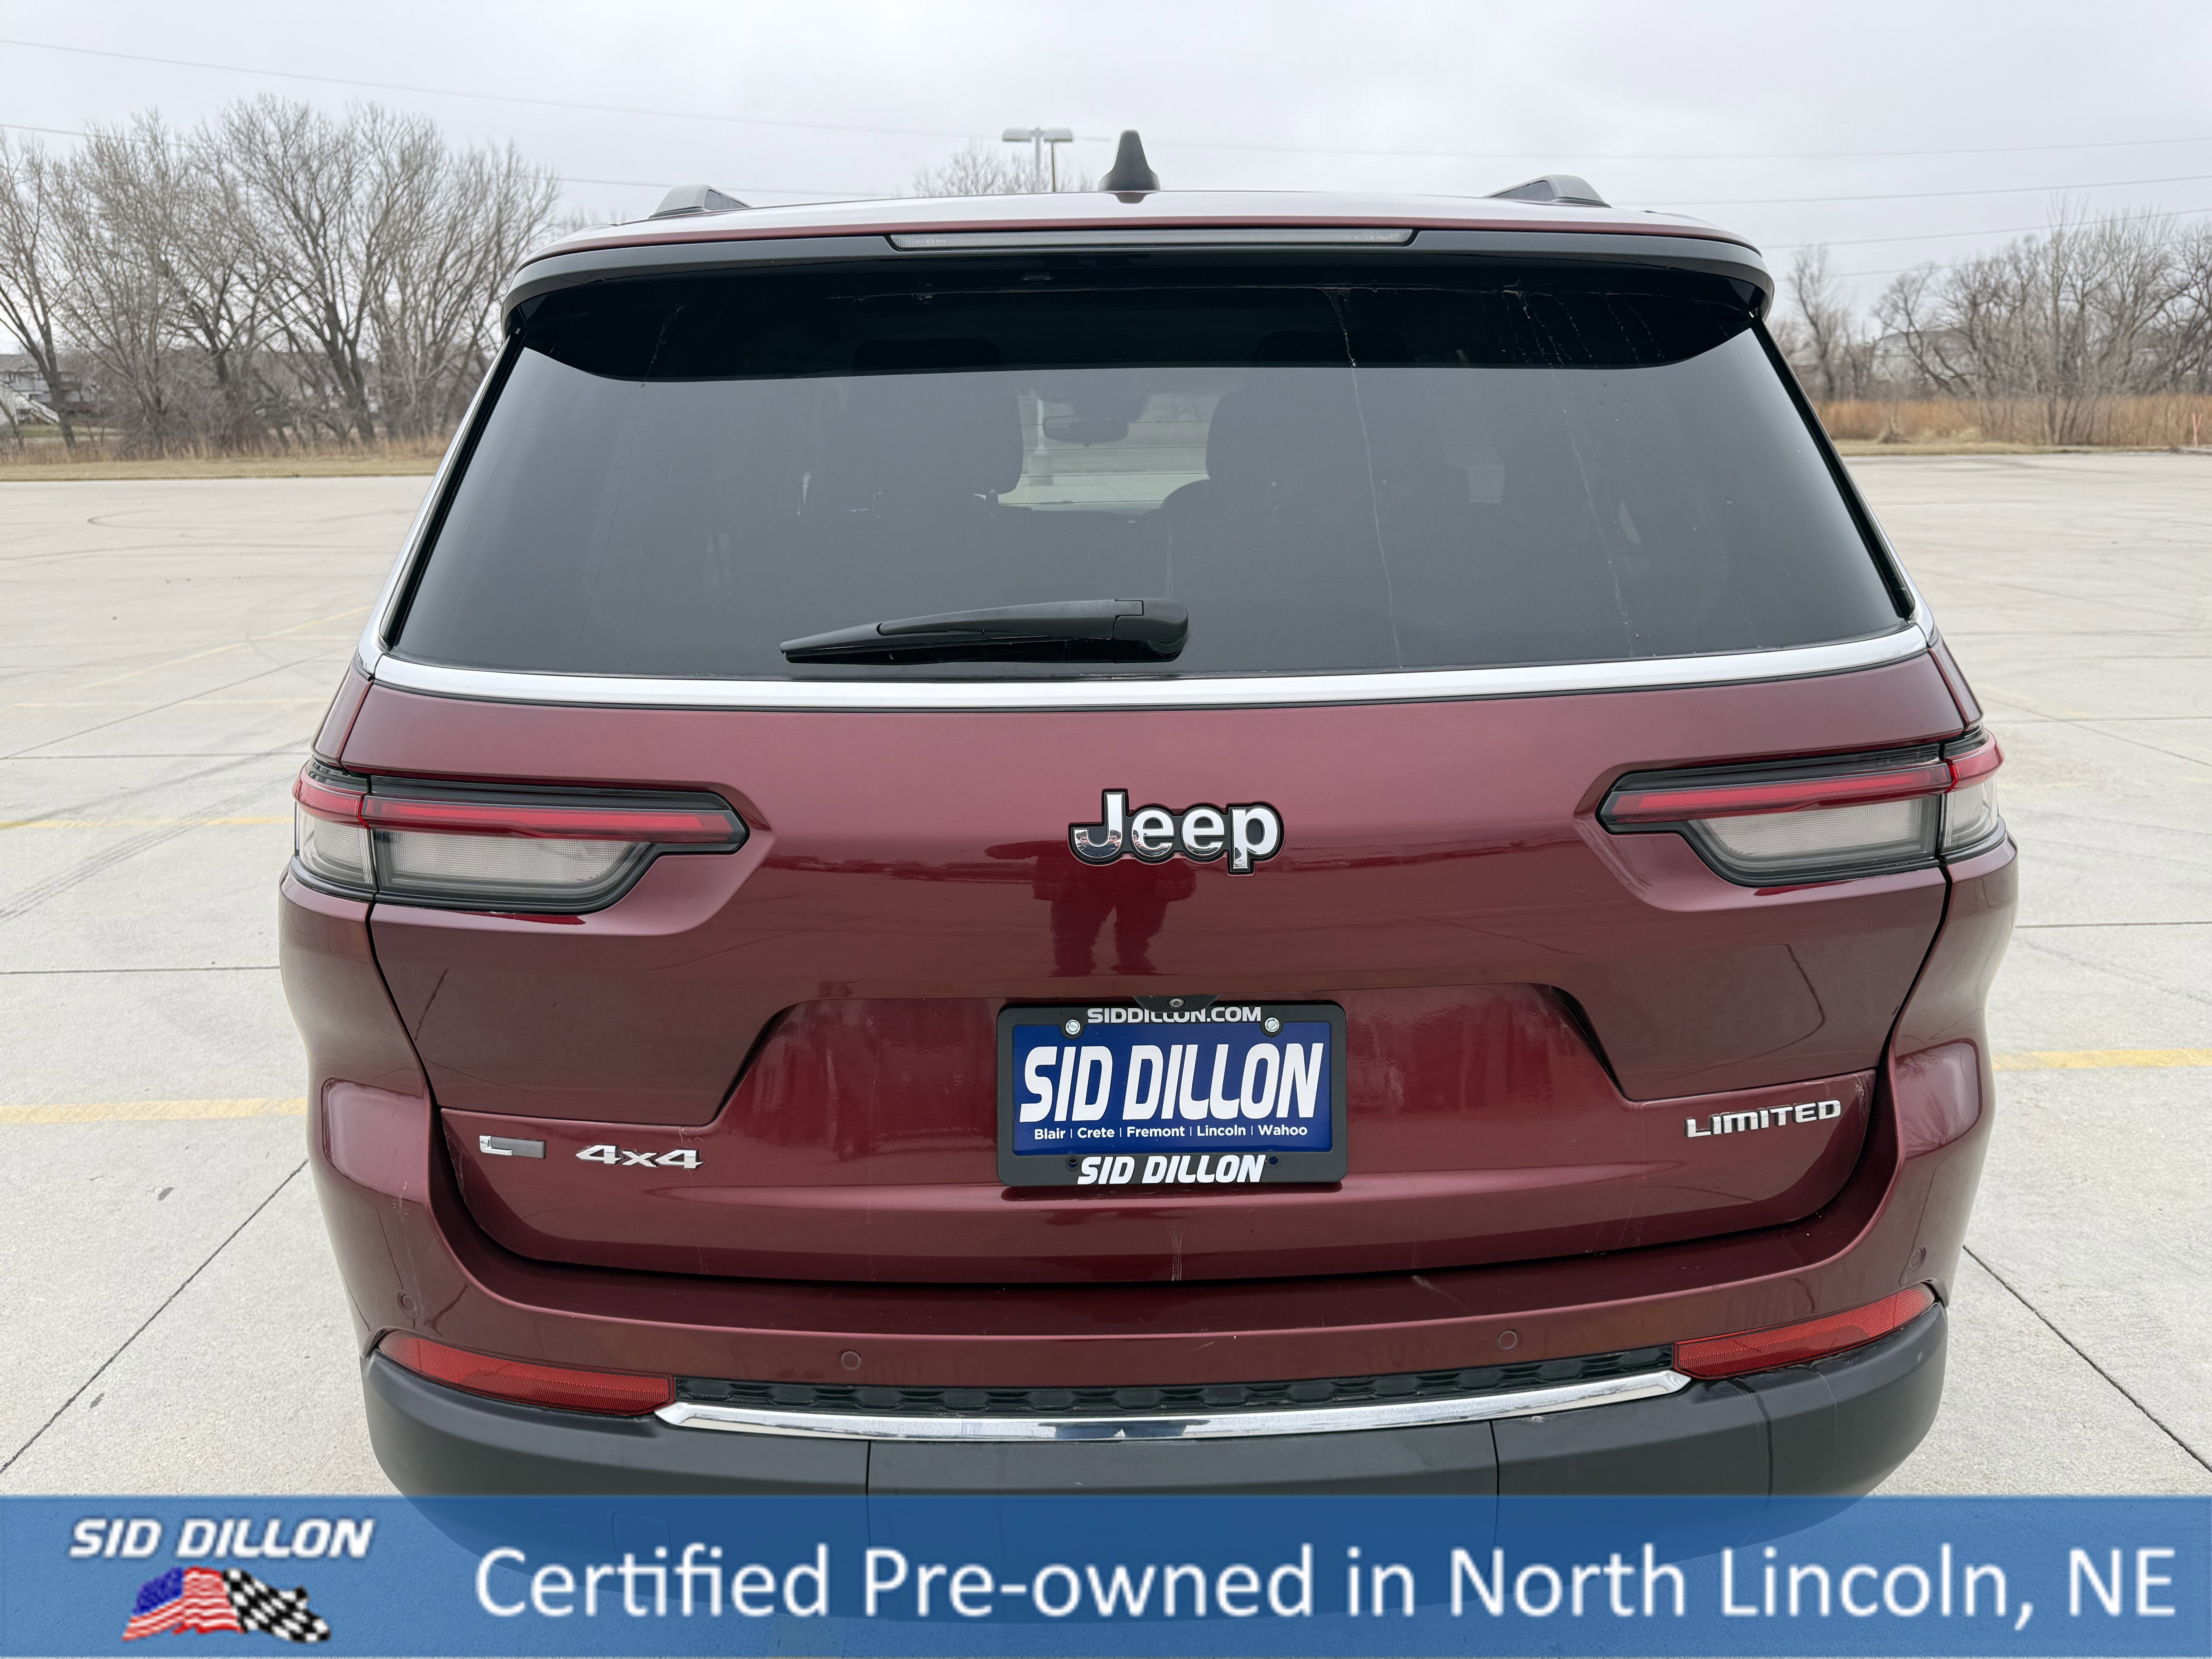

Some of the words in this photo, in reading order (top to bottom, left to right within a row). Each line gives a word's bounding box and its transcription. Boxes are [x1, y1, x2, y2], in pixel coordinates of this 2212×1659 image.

[1072, 792, 1279, 870] Jeep
[1087, 1006, 1261, 1024] SIDDILLON.COM
[1019, 1046, 1113, 1123] SID
[1122, 1042, 1324, 1120] DILLON
[1034, 1127, 1066, 1140] Blair
[1077, 1127, 1115, 1139] Crete
[1127, 1126, 1185, 1138] Fremont
[1197, 1124, 1246, 1137] Lincoln
[1258, 1124, 1308, 1136] Wahoo
[1685, 1099, 1841, 1138] LIMITED
[575, 1144, 705, 1170] 4x4
[1077, 1156, 1135, 1185] SID
[1142, 1154, 1266, 1184] DILLON
